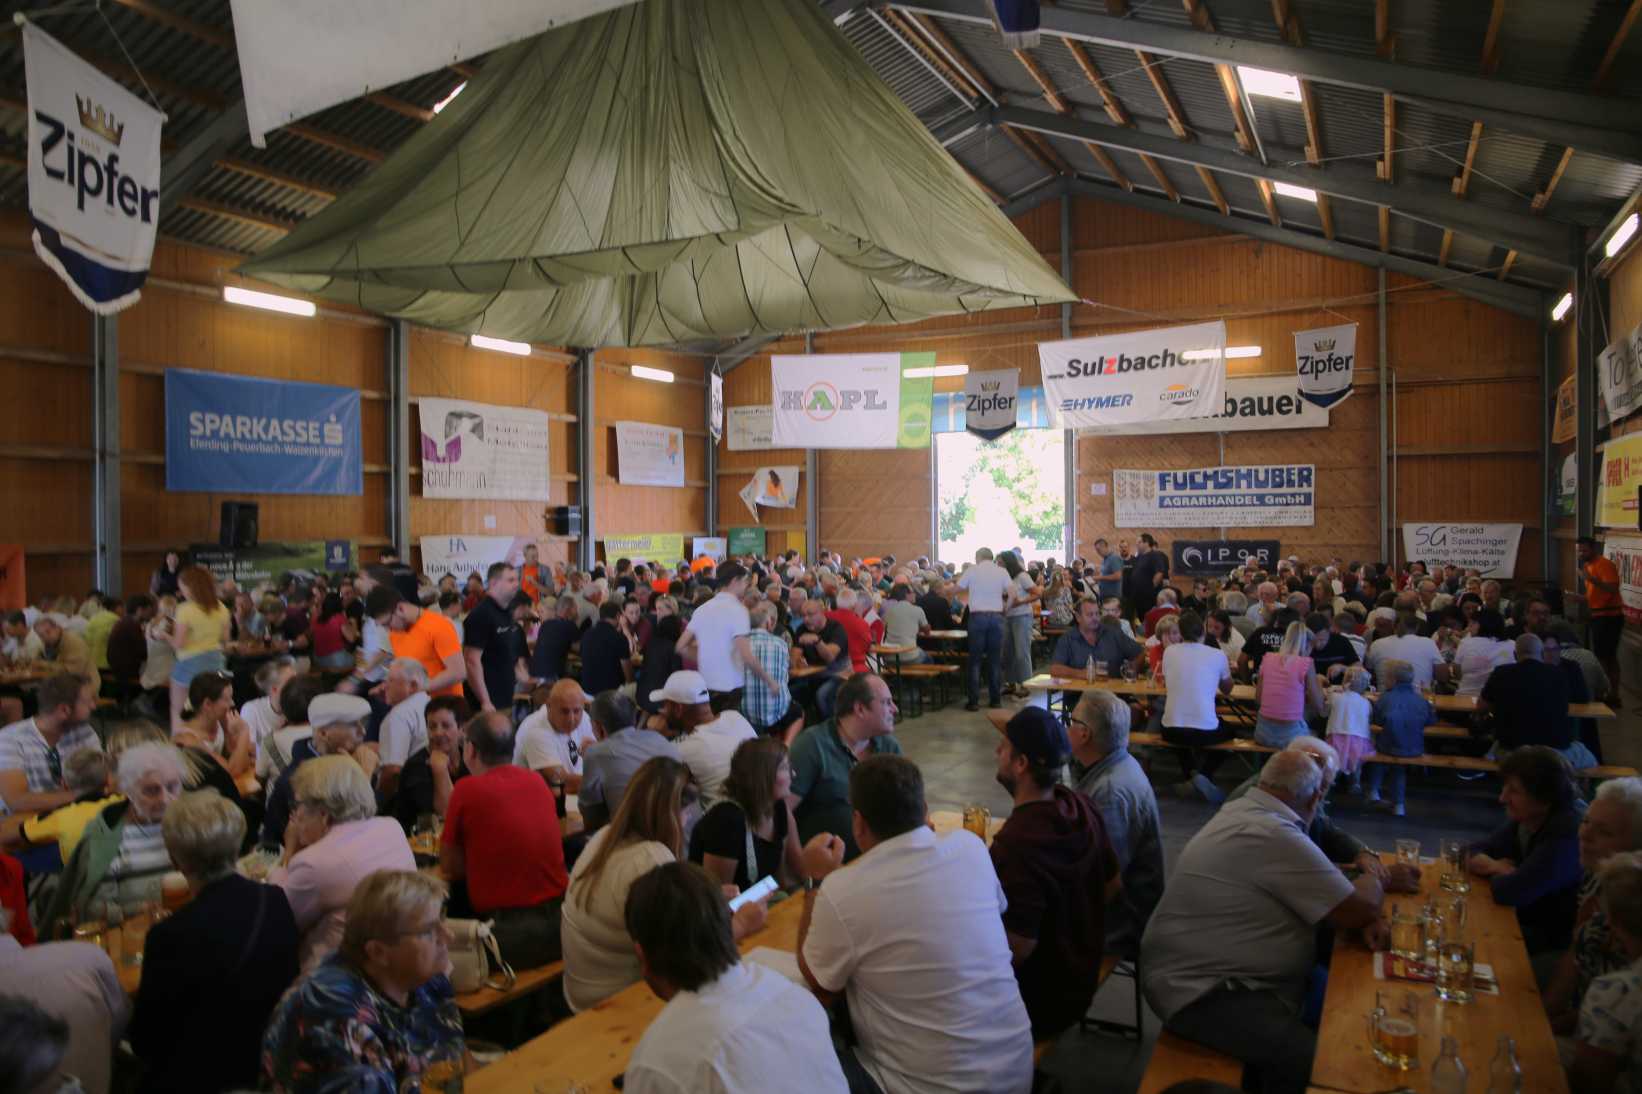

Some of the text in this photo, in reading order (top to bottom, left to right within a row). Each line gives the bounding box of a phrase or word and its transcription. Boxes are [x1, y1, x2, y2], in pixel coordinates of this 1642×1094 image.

[35, 109, 159, 224] Zipfer
[1298, 353, 1354, 380] Zipfer
[966, 393, 1015, 417] Zipfer
[1064, 393, 1134, 411] HYMER
[189, 410, 321, 444] SPARKASSE
[1158, 466, 1313, 491] FUCHSHUBER
[1163, 493, 1305, 507] AGRARHANDEL GmbH
[1450, 526, 1484, 535] Gerald
[1450, 536, 1507, 546] Spachinger
